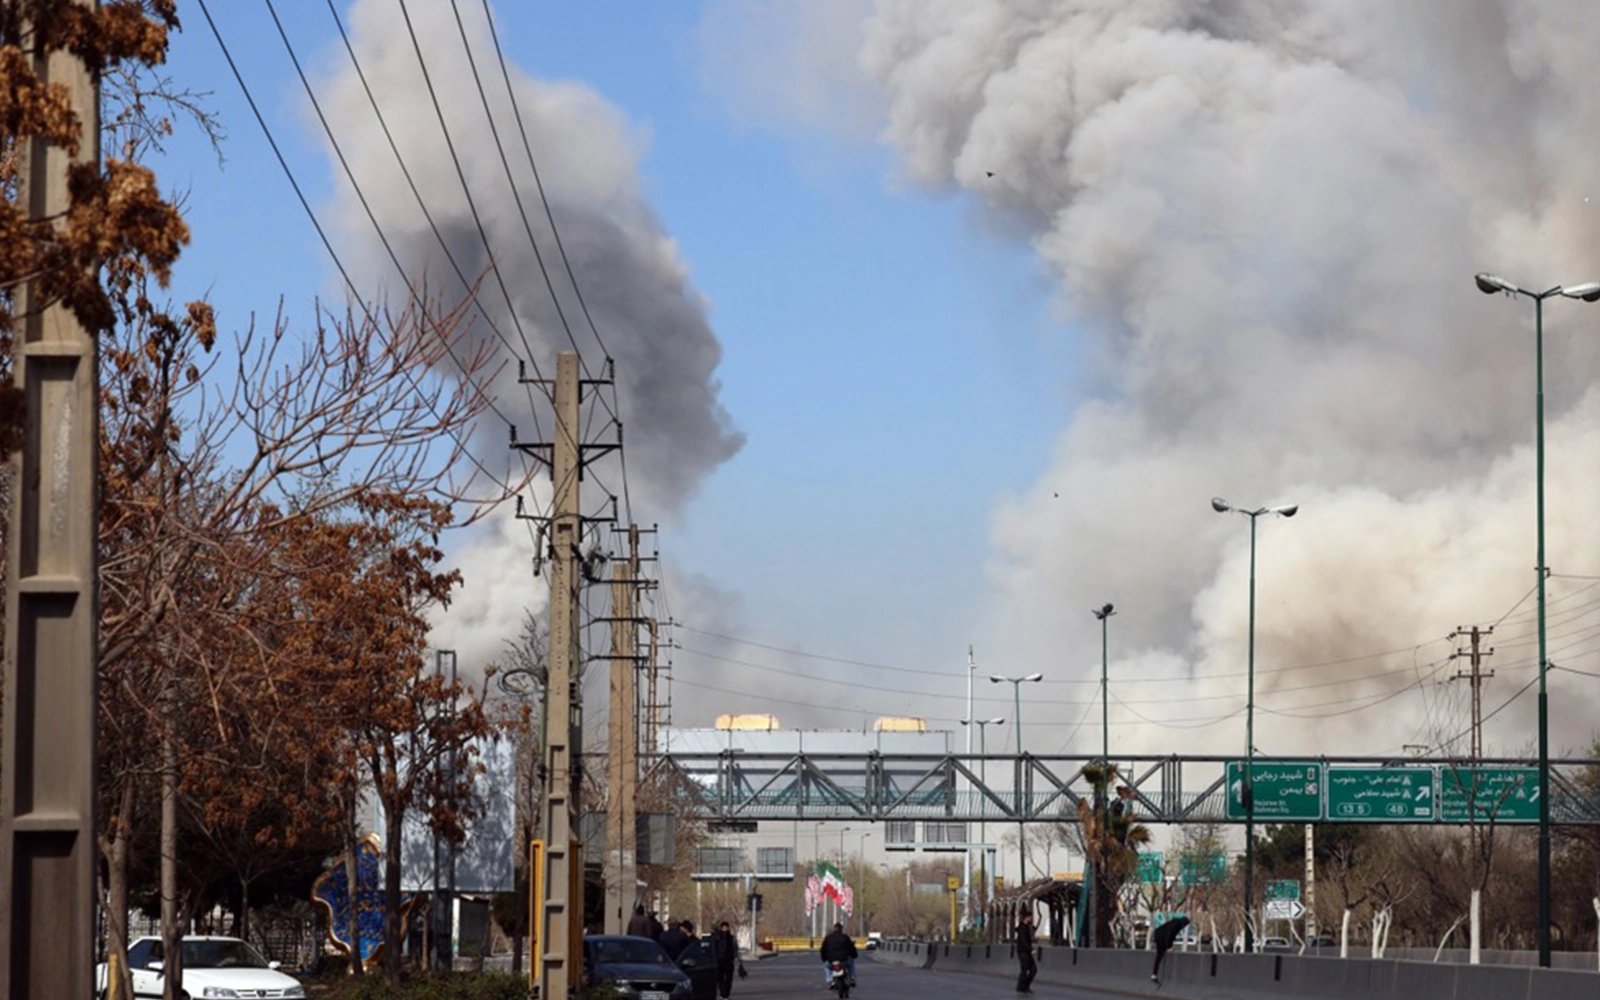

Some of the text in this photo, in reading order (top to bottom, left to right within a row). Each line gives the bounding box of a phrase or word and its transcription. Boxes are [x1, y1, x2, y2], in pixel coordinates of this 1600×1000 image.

[1279, 769, 1303, 781] شهید
[1381, 788, 1401, 798] شهید
[1343, 804, 1354, 814] 13
[1389, 804, 1404, 814] 48
